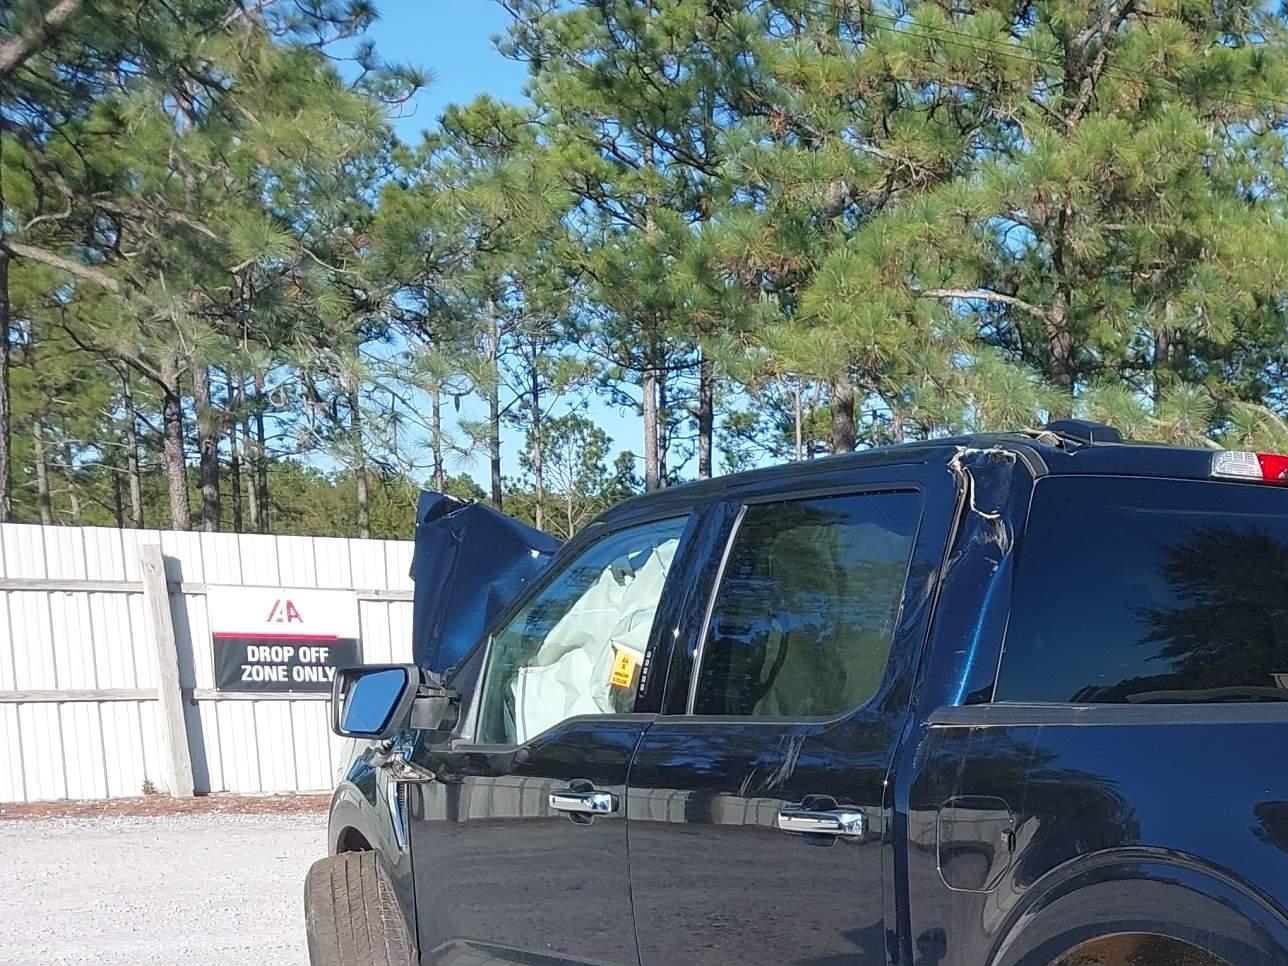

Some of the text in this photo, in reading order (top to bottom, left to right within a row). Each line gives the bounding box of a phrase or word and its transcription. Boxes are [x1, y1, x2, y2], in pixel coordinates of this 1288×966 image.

[247, 646, 329, 662] DROP OFF
[241, 665, 336, 682] ZONE ONLY
